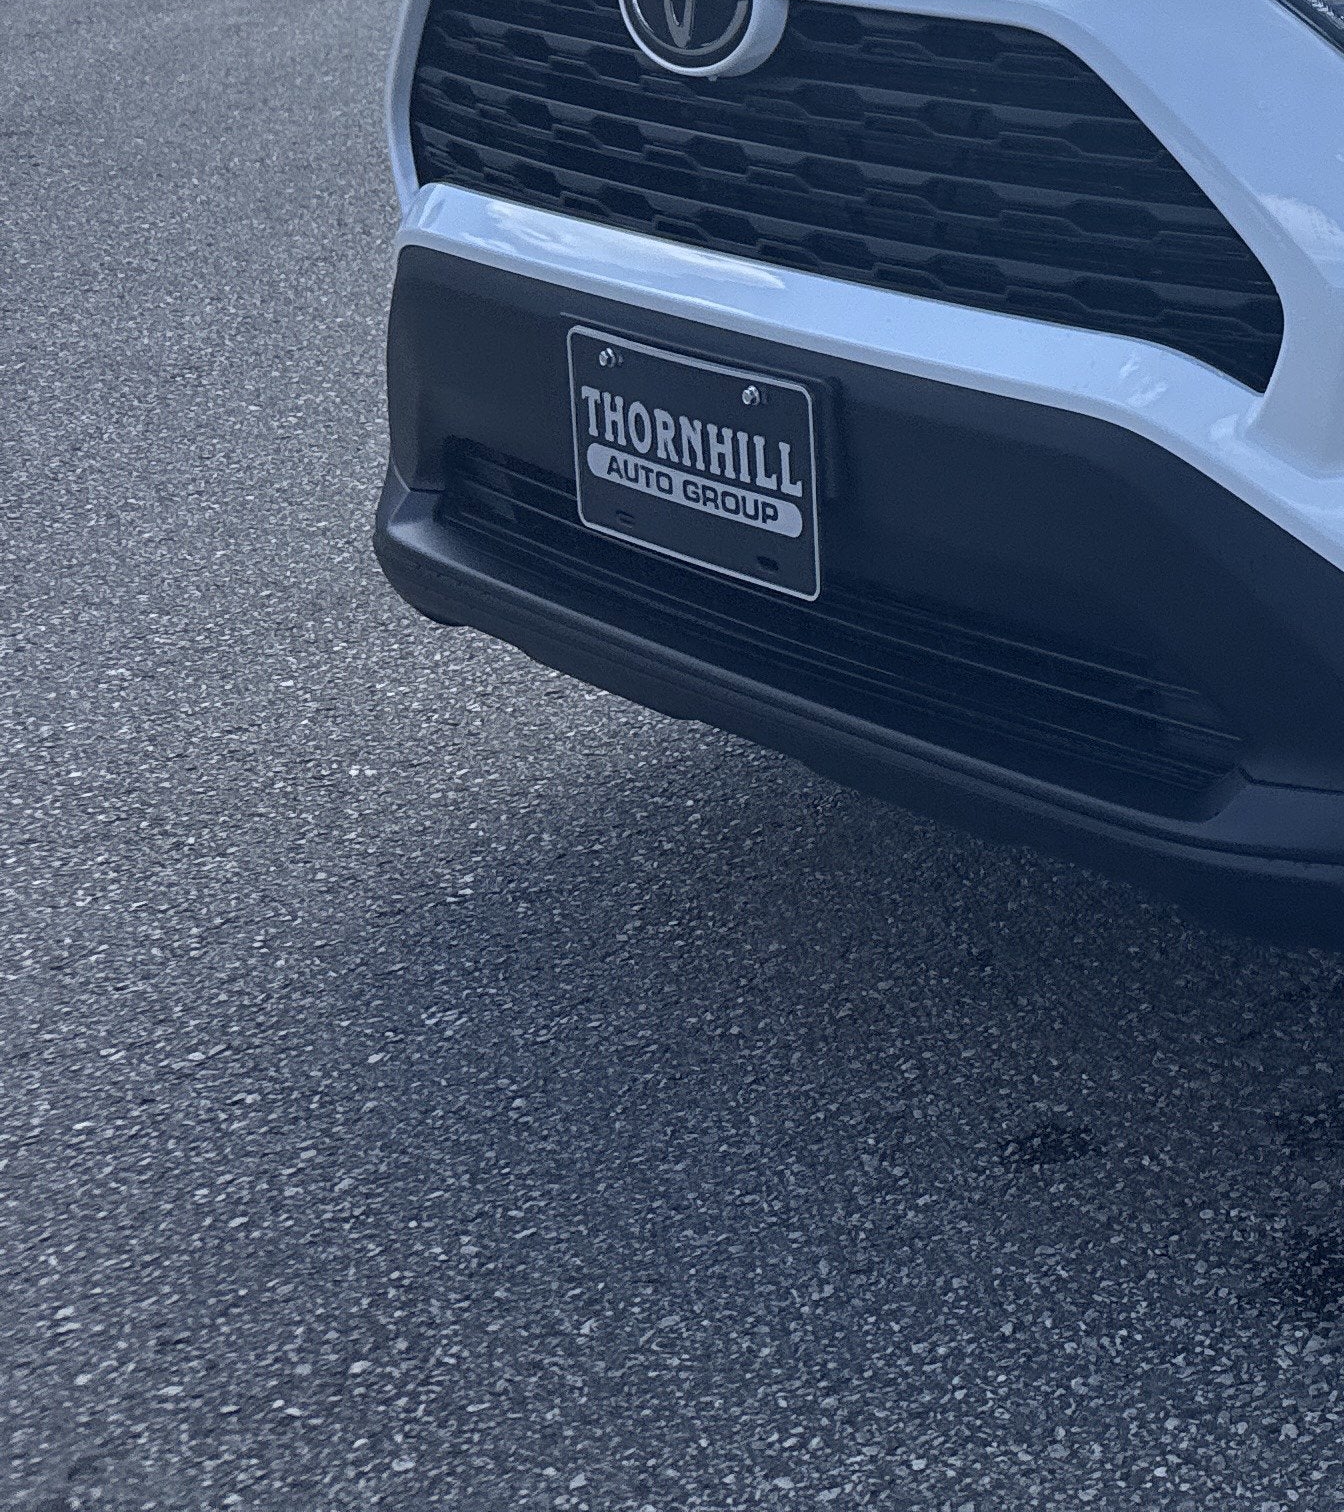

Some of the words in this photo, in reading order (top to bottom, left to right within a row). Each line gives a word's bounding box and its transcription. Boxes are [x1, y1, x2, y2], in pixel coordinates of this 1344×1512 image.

[582, 386, 803, 498] THORNHILL
[606, 455, 674, 494] AUTO
[682, 479, 779, 524] GROUP
